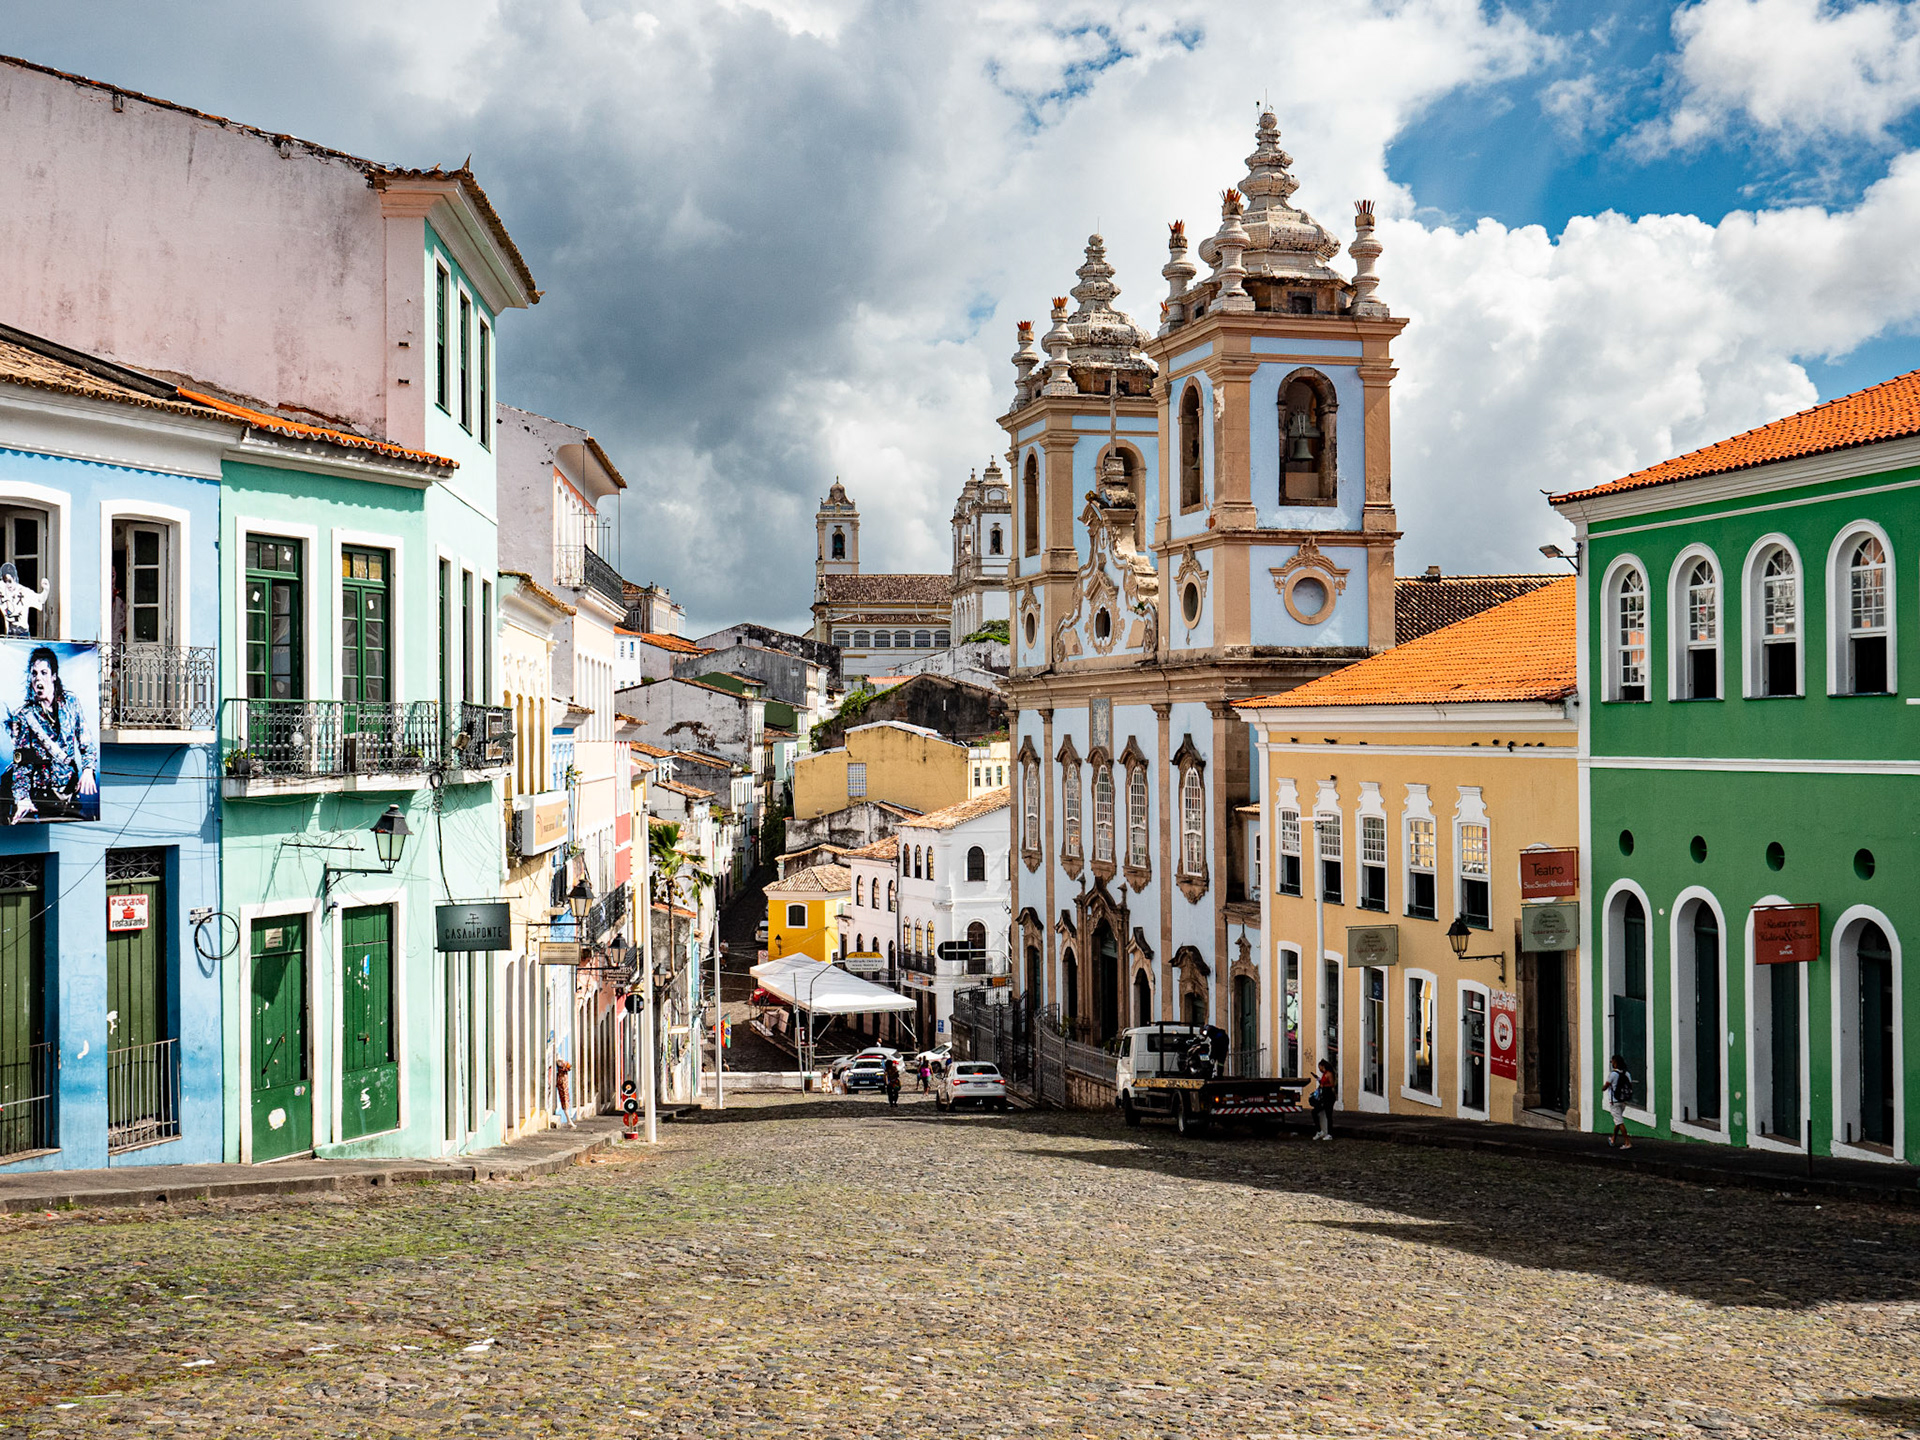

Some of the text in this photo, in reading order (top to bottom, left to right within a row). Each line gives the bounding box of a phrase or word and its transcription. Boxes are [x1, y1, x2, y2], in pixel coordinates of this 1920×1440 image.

[1530, 862, 1564, 877] Teatro
[111, 918, 146, 929] restaurante
[445, 927, 468, 940] CASA
[476, 926, 503, 938] PONTE
